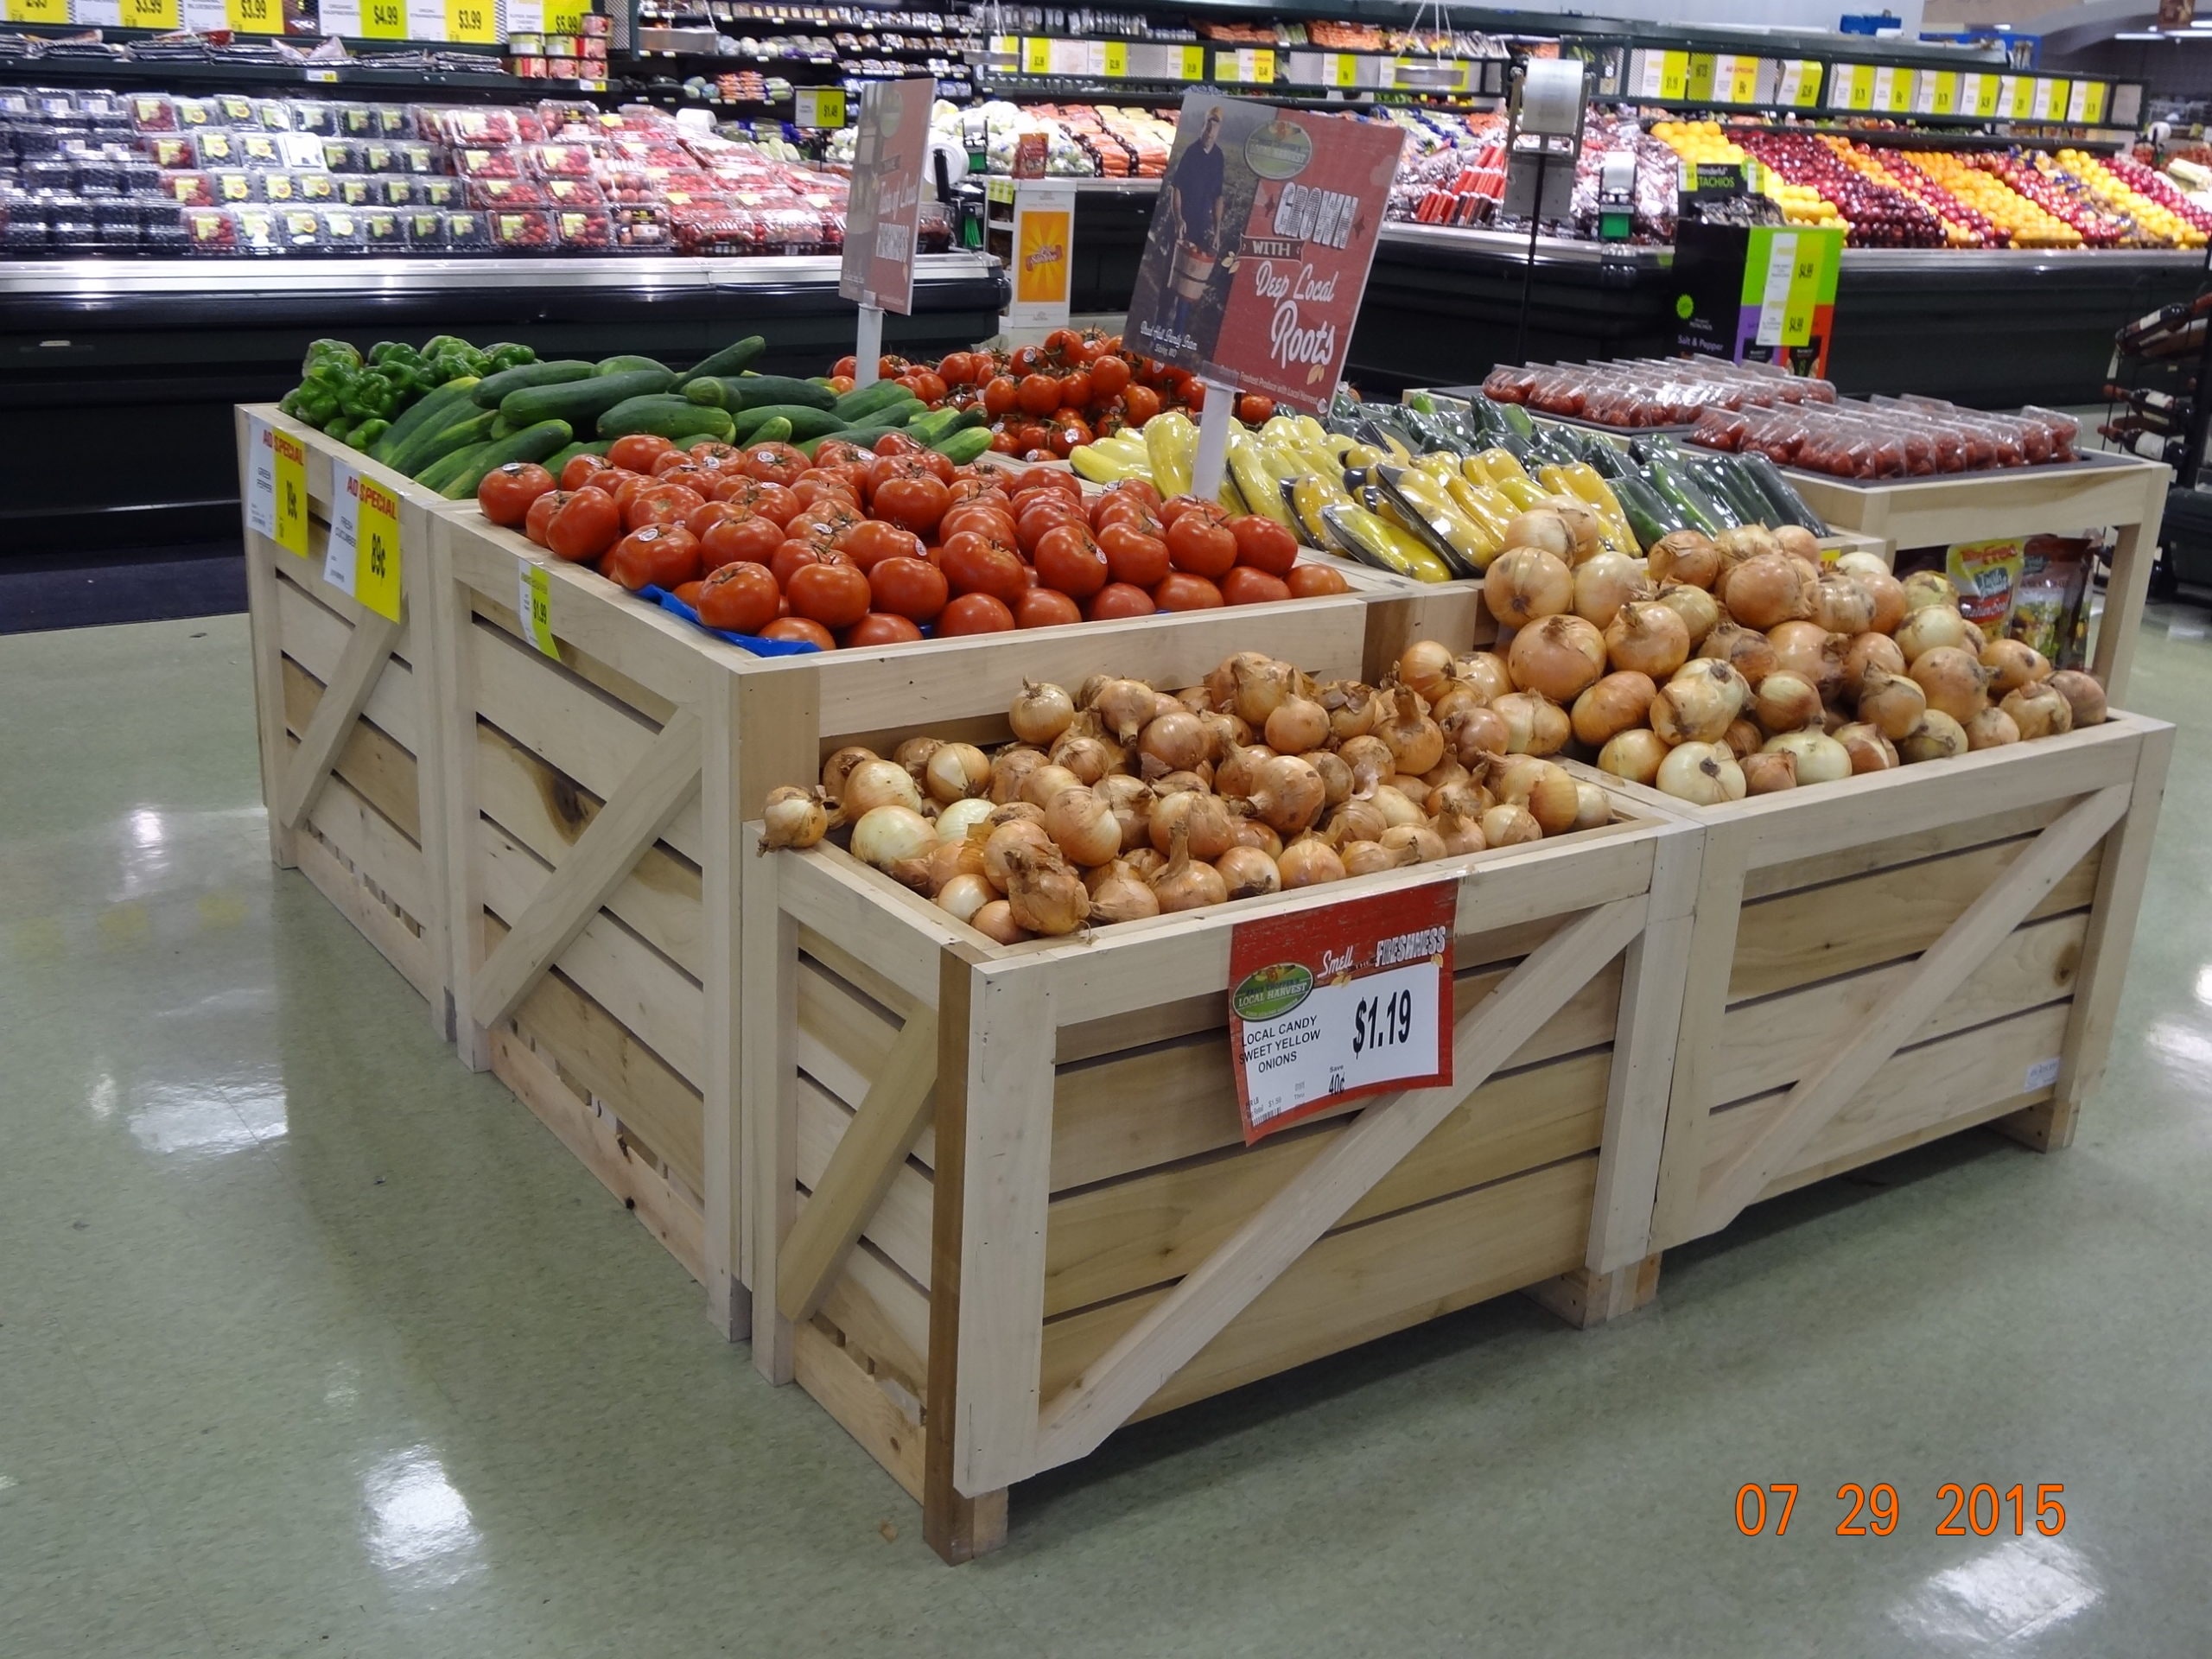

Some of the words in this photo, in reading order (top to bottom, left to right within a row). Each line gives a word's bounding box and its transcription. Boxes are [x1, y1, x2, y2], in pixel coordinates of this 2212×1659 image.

[240, 0, 267, 19] $3.99
[373, 5, 397, 26] $4.99
[458, 10, 482, 30] $3.99
[1274, 181, 1359, 250] GROWN
[1252, 239, 1291, 257] WITH
[1255, 260, 1290, 308] Deep
[1293, 263, 1339, 302] Local
[1270, 300, 1336, 370] Roots
[1699, 338, 1725, 352] Pepper
[263, 429, 273, 449] AD
[273, 435, 304, 467] SPECIAL
[347, 475, 359, 498] AD
[359, 484, 397, 521] SPECIAL
[1317, 945, 1354, 978] Smell
[1375, 925, 1446, 967] FRESHNESS
[1238, 991, 1265, 1007] LOCAL
[1267, 982, 1307, 999] HARVEST
[1242, 1027, 1275, 1047] LOCAL
[1279, 1014, 1318, 1035] CANDY
[1352, 988, 1412, 1060] $1.19
[1238, 1042, 1273, 1065] SWEET
[1274, 1028, 1321, 1051] YELLOW
[1258, 1050, 1298, 1073] ONIONS
[1328, 1071, 1345, 1096] 40¢
